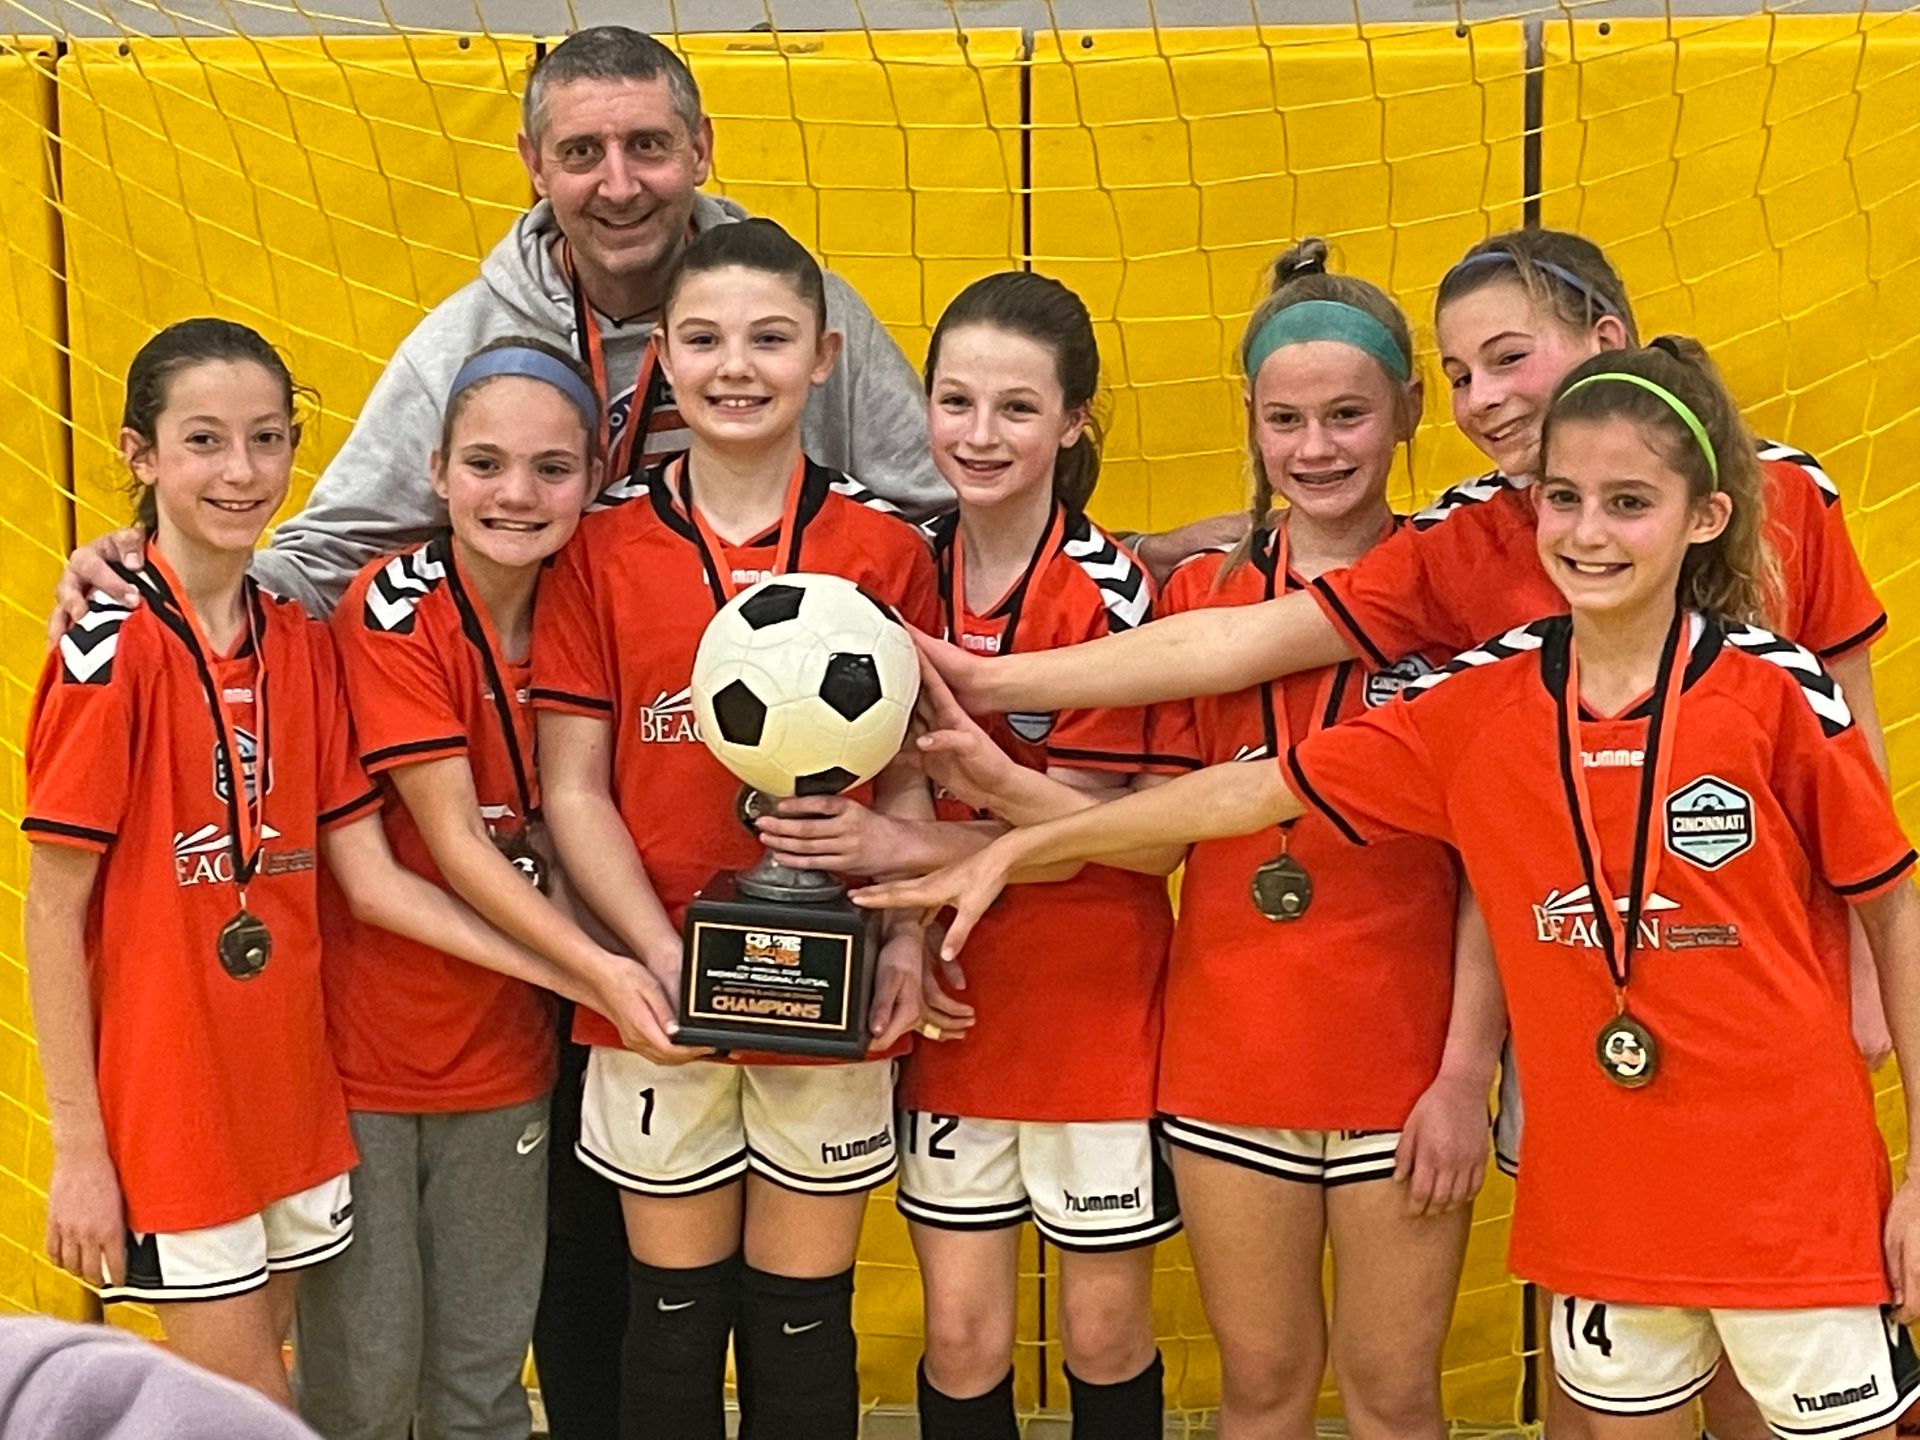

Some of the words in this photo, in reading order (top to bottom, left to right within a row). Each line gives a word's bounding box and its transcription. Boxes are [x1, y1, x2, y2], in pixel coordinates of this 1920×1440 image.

[943, 626, 1001, 652] mmel
[640, 706, 704, 743] BEA
[1580, 749, 1645, 768] umme
[1672, 814, 1745, 833] CINCINNATI
[1531, 903, 1660, 949] BEAN
[712, 996, 821, 1018] CHAMPIONS
[639, 1087, 655, 1136] 1
[821, 1123, 892, 1164] hummel
[908, 1110, 959, 1160] 12
[1063, 1187, 1141, 1212] hummel
[1564, 1296, 1613, 1358] 14
[1792, 1374, 1879, 1413] hummel
